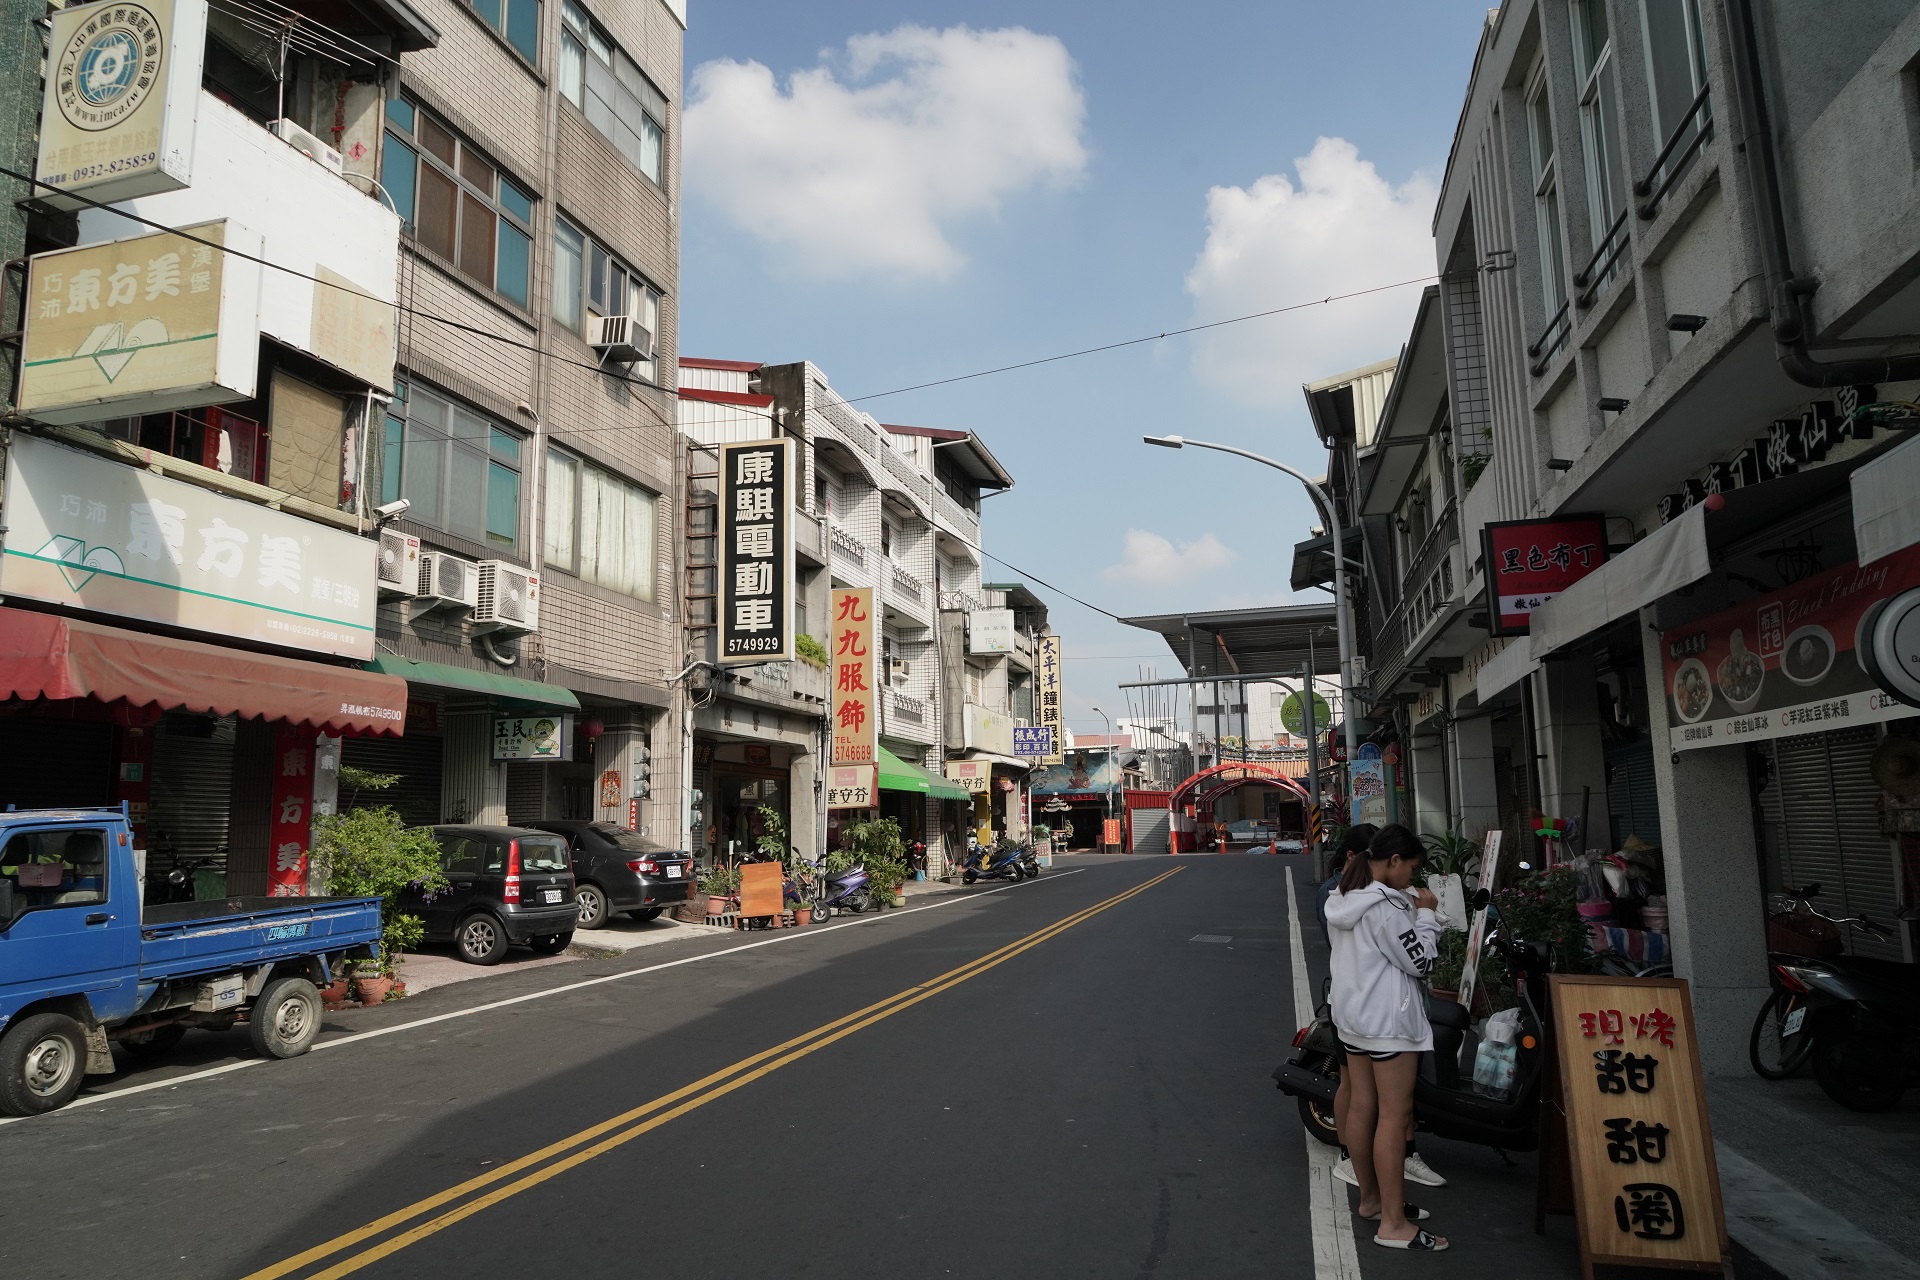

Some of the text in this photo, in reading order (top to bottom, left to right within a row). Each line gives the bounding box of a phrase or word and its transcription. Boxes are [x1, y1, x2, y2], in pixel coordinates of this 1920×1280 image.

[74, 90, 139, 123] www.imca.tw
[73, 152, 156, 182] 0932-825859
[66, 252, 181, 314] 東方美
[190, 244, 213, 294] 漢堡
[126, 498, 302, 595] 東方美
[734, 450, 774, 633] 康騏電動車
[1501, 542, 1597, 574] 黑色布丁
[1787, 565, 1889, 624] Black Pudding
[729, 637, 779, 652] 5749929
[837, 594, 869, 734] 九九服飾
[835, 744, 872, 761] 5746689
[276, 748, 307, 872] 東方美
[1578, 1008, 1676, 1049] 現烤
[1593, 1049, 1685, 1240] 甜甜圈
